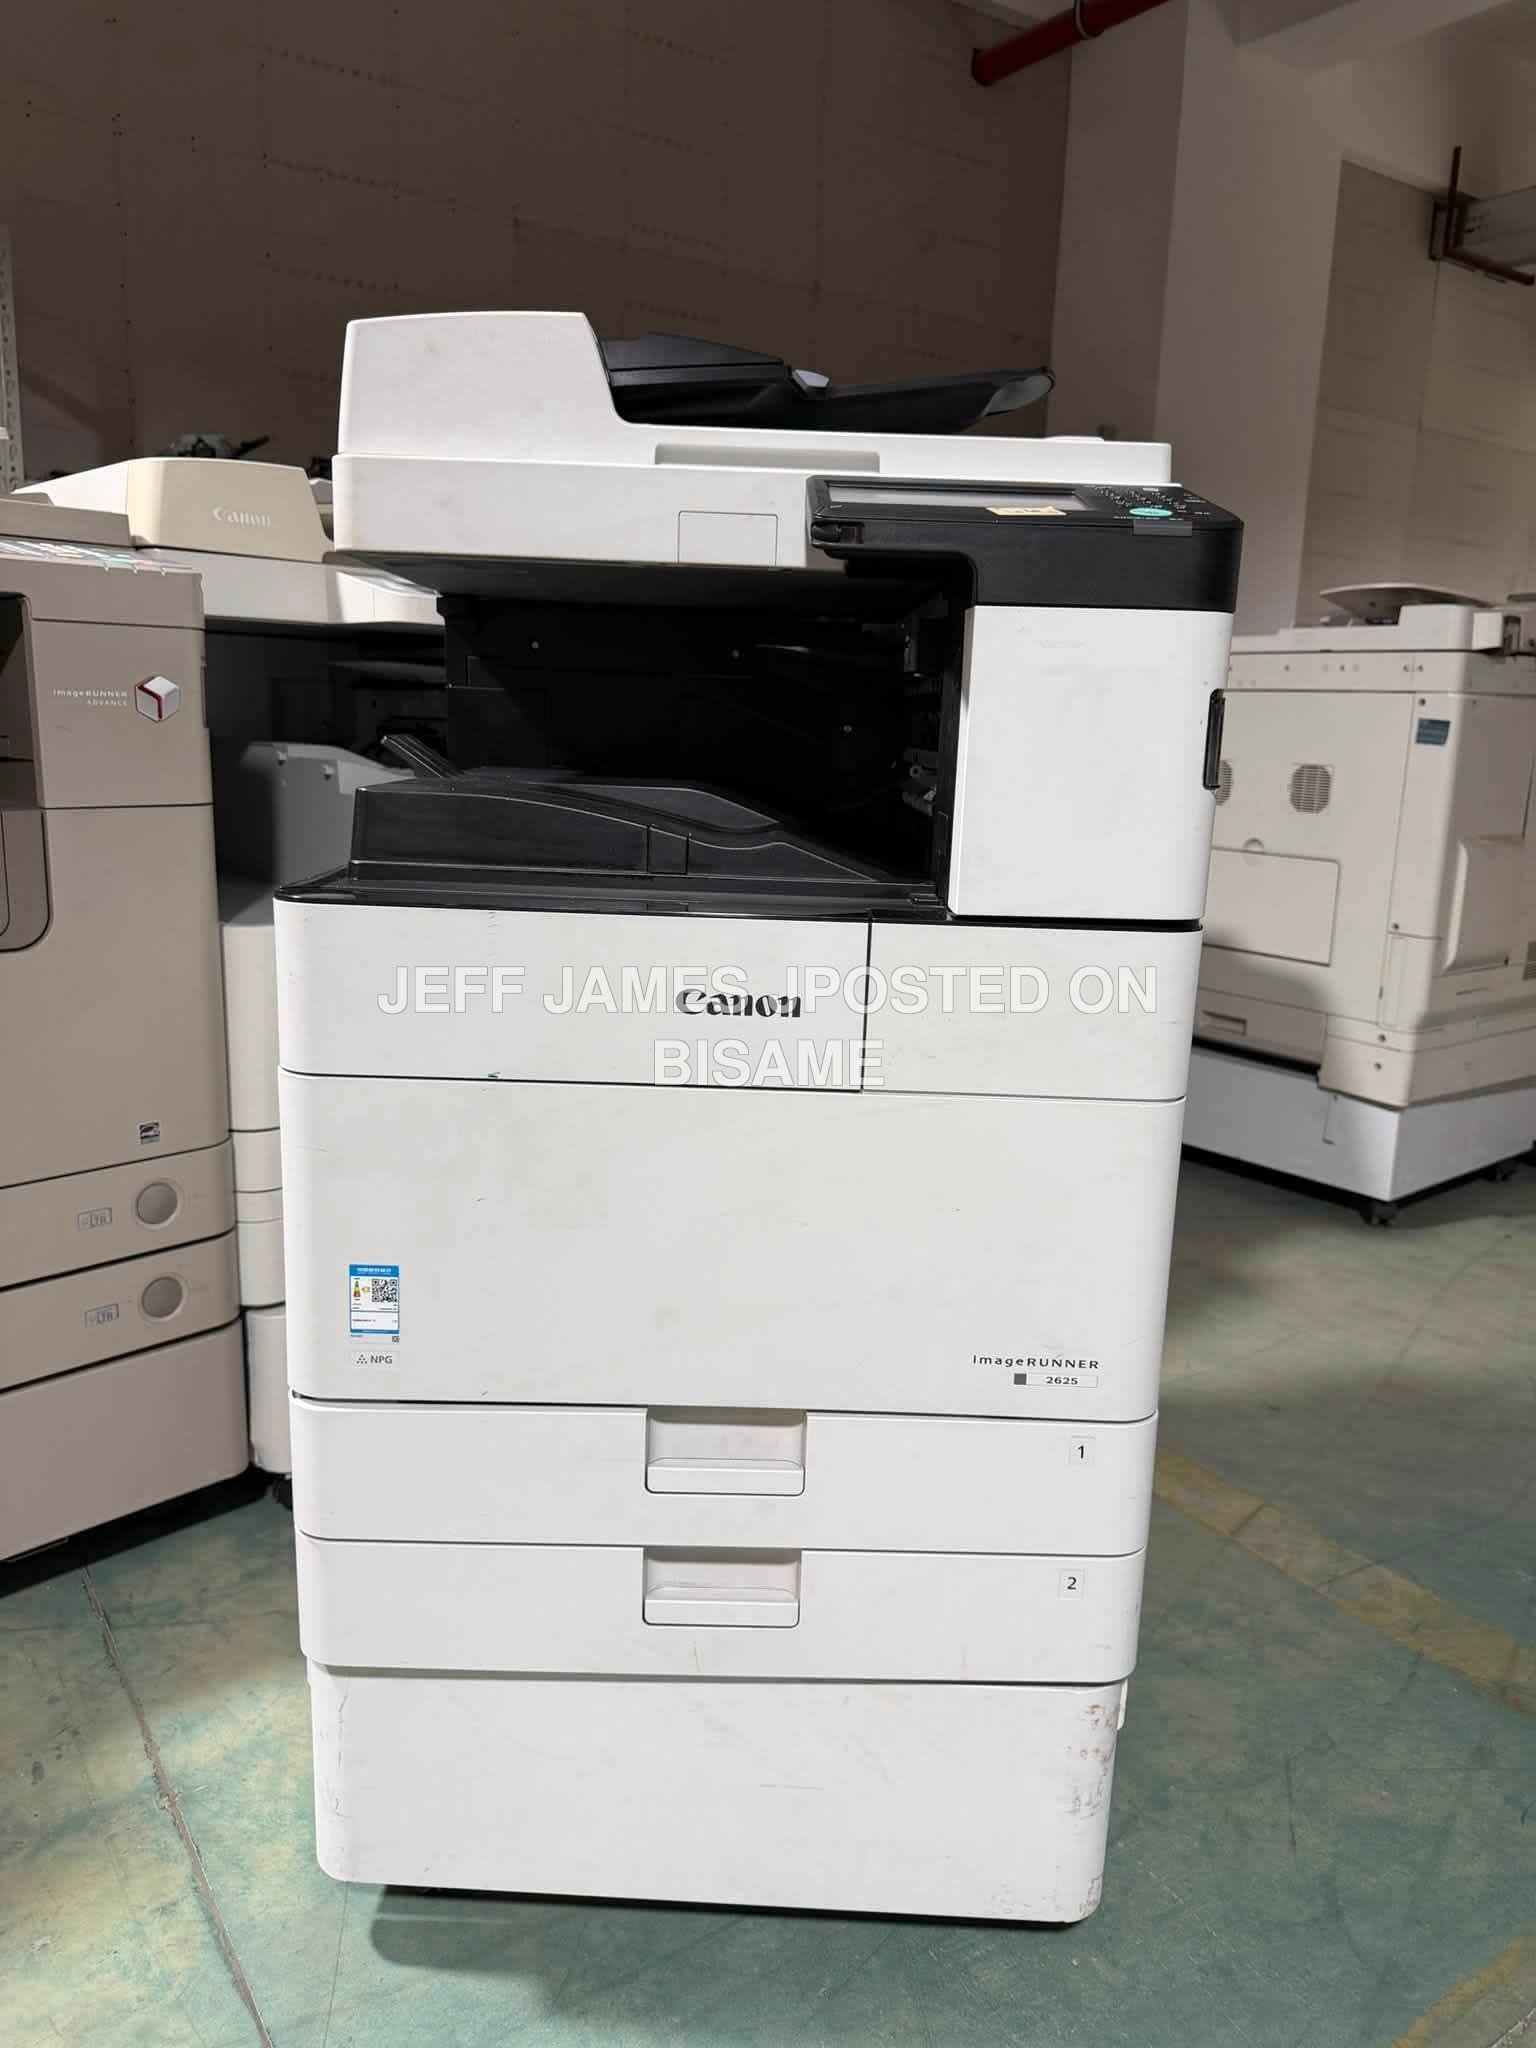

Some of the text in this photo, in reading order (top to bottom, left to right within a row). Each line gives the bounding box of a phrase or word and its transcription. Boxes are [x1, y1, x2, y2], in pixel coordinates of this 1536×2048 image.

[675, 988, 801, 1018] Canon
[370, 1355, 393, 1364] NPG
[1045, 1376, 1079, 1385] 2625
[1077, 1445, 1085, 1459] 1
[1066, 1576, 1077, 1590] 2
